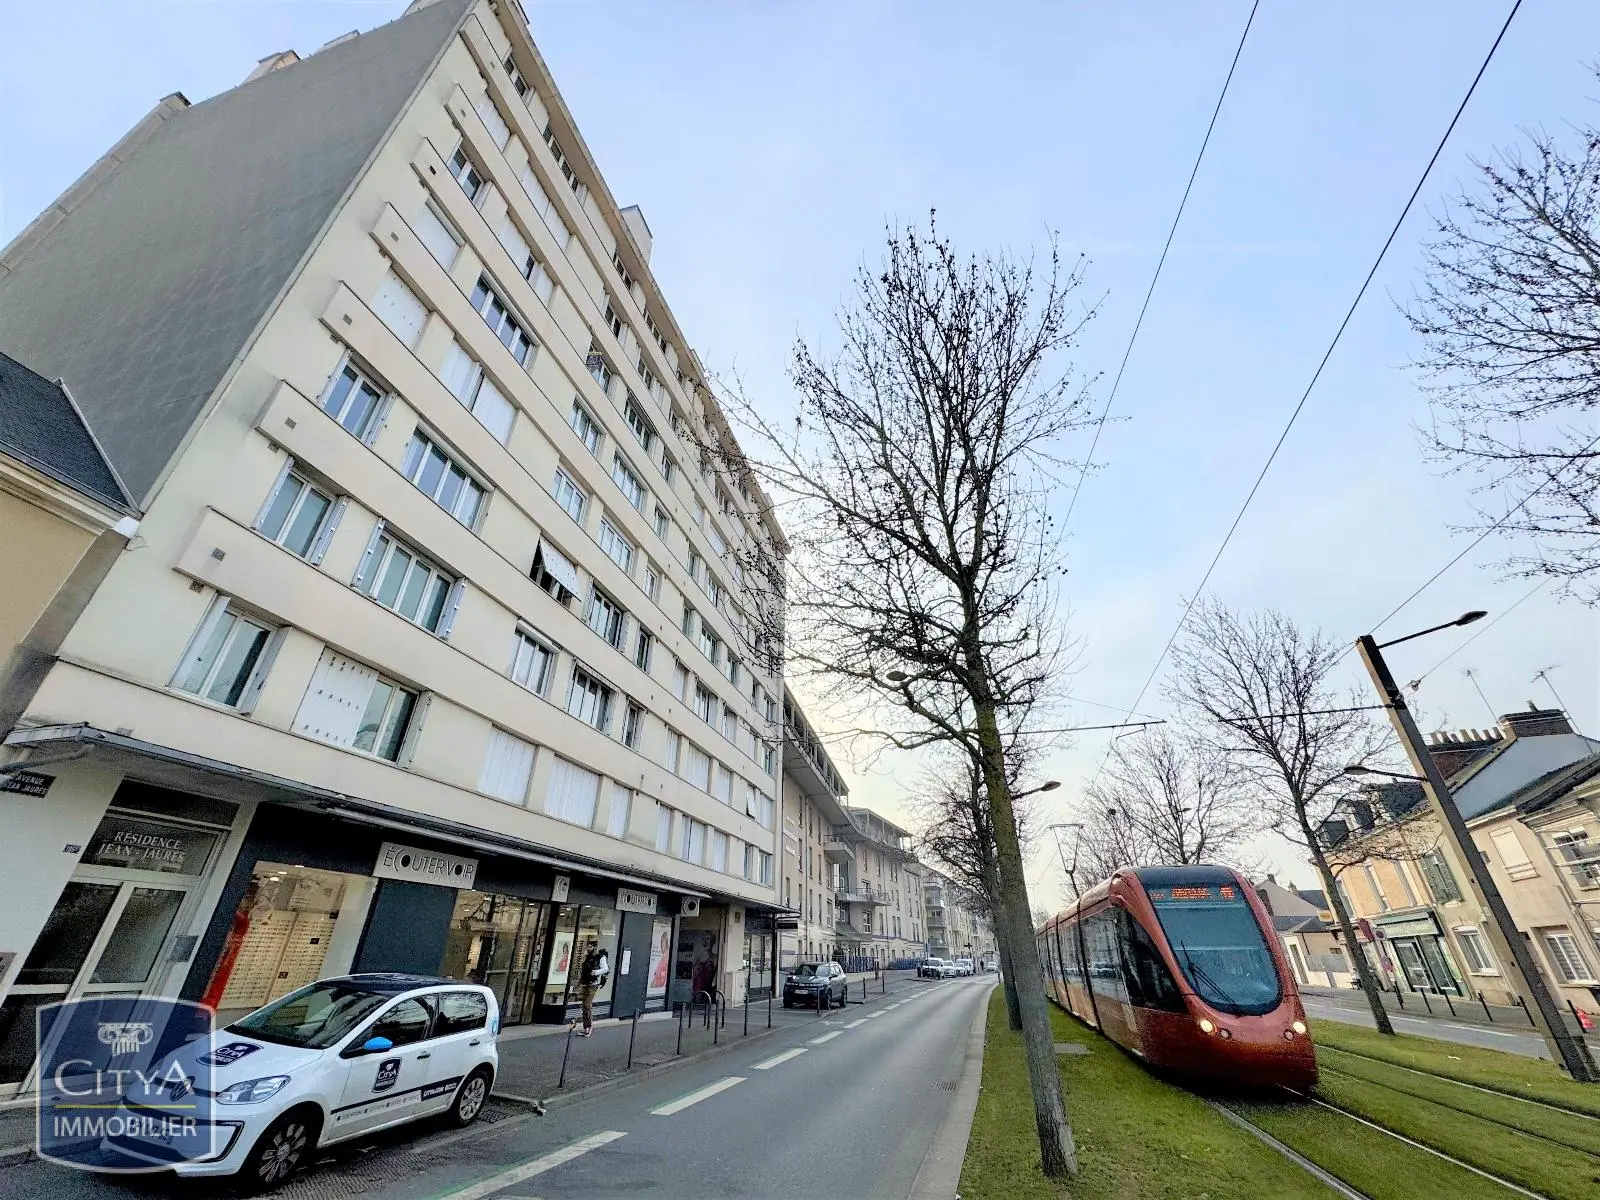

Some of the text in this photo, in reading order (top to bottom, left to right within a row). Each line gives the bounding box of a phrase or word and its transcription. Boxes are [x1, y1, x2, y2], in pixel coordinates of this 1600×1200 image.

[16, 774, 45, 786] AVENUE
[96, 843, 133, 856] JEAN
[383, 846, 444, 875] ÉCOUTER
